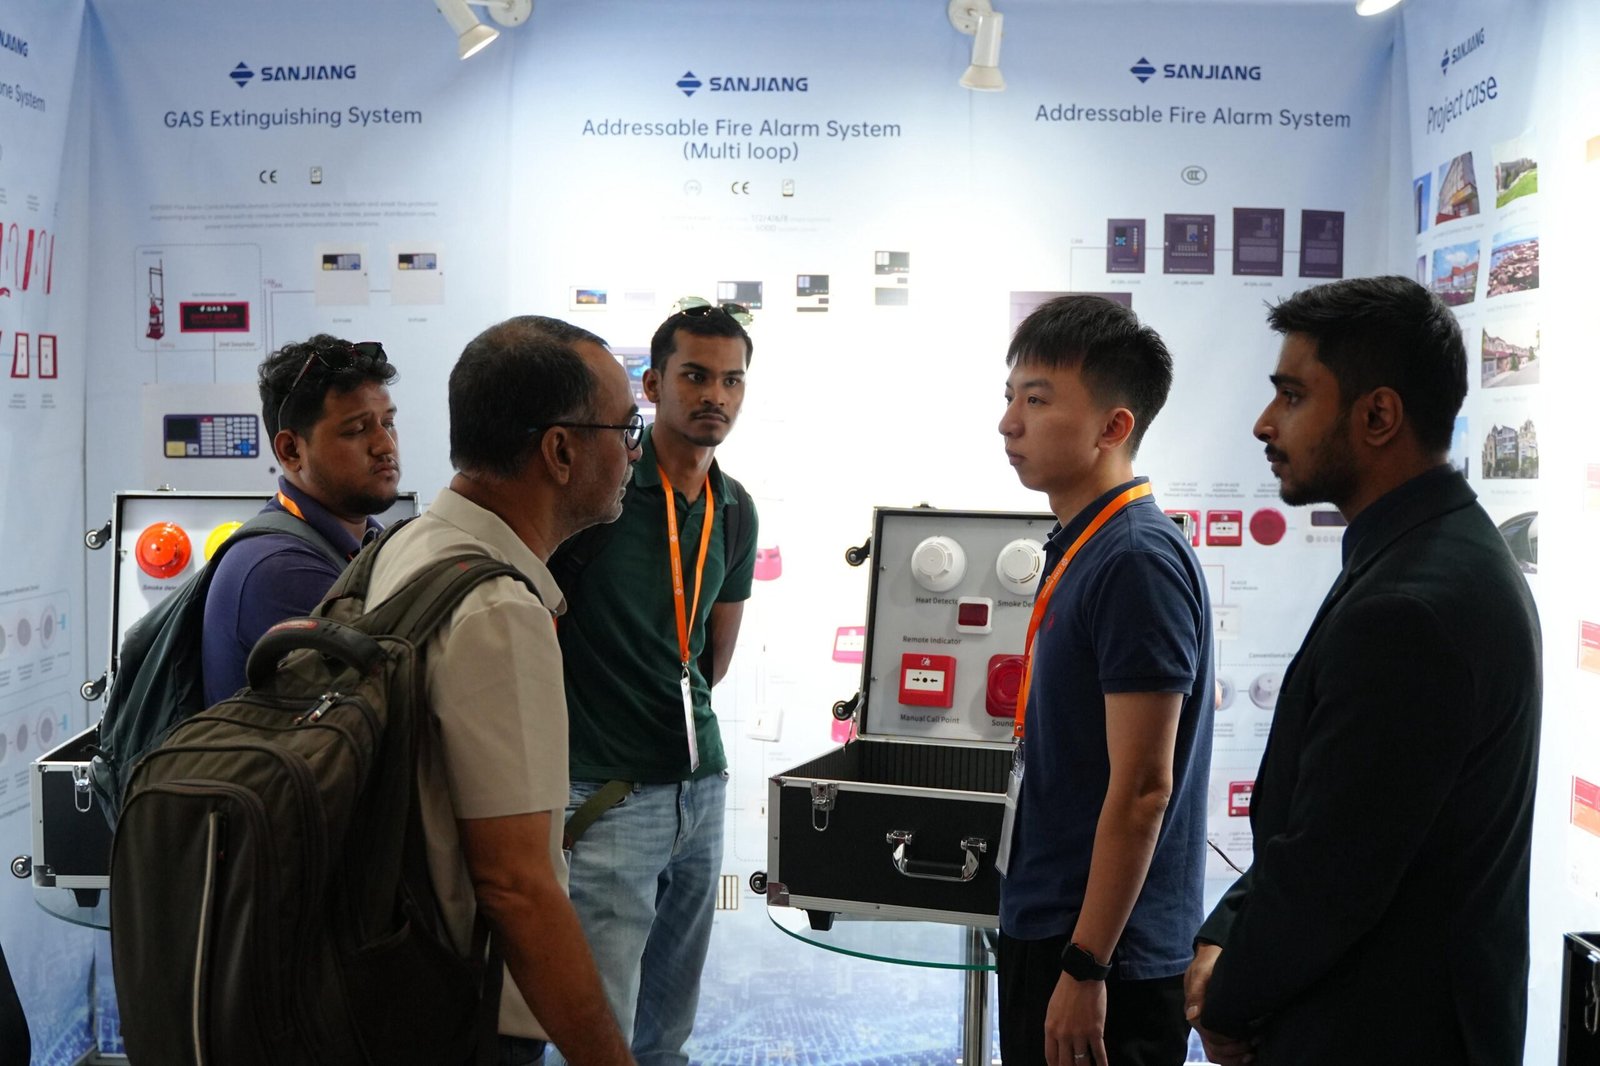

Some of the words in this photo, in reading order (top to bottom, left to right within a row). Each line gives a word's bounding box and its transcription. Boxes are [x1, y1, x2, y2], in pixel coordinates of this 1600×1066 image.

[1451, 27, 1485, 65] SANJIANG
[261, 64, 356, 82] SANJIANG
[1163, 64, 1261, 80] SANJIANG
[709, 77, 808, 92] SANJIANG
[0, 79, 13, 99] ne
[15, 83, 45, 112] System
[1426, 89, 1463, 135] Project
[1465, 76, 1498, 111] case
[163, 109, 204, 128] GAS
[210, 107, 342, 130] Extinguishing
[347, 106, 422, 127] System
[1035, 103, 1163, 123] Addressable
[1169, 106, 1206, 124] Fire
[1213, 107, 1272, 126] Alarm
[1279, 108, 1351, 130] System
[581, 118, 709, 136] Addressable
[715, 118, 752, 136] Fire
[759, 119, 820, 137] Alarm
[826, 120, 902, 141] System
[682, 141, 741, 161] (Multi
[747, 142, 799, 164] loop)
[915, 597, 931, 605] Heat
[930, 637, 962, 645] Indicator
[900, 714, 926, 722] Manual
[926, 715, 940, 723] Call
[941, 716, 960, 724] Point
[991, 719, 1014, 728] Sound
